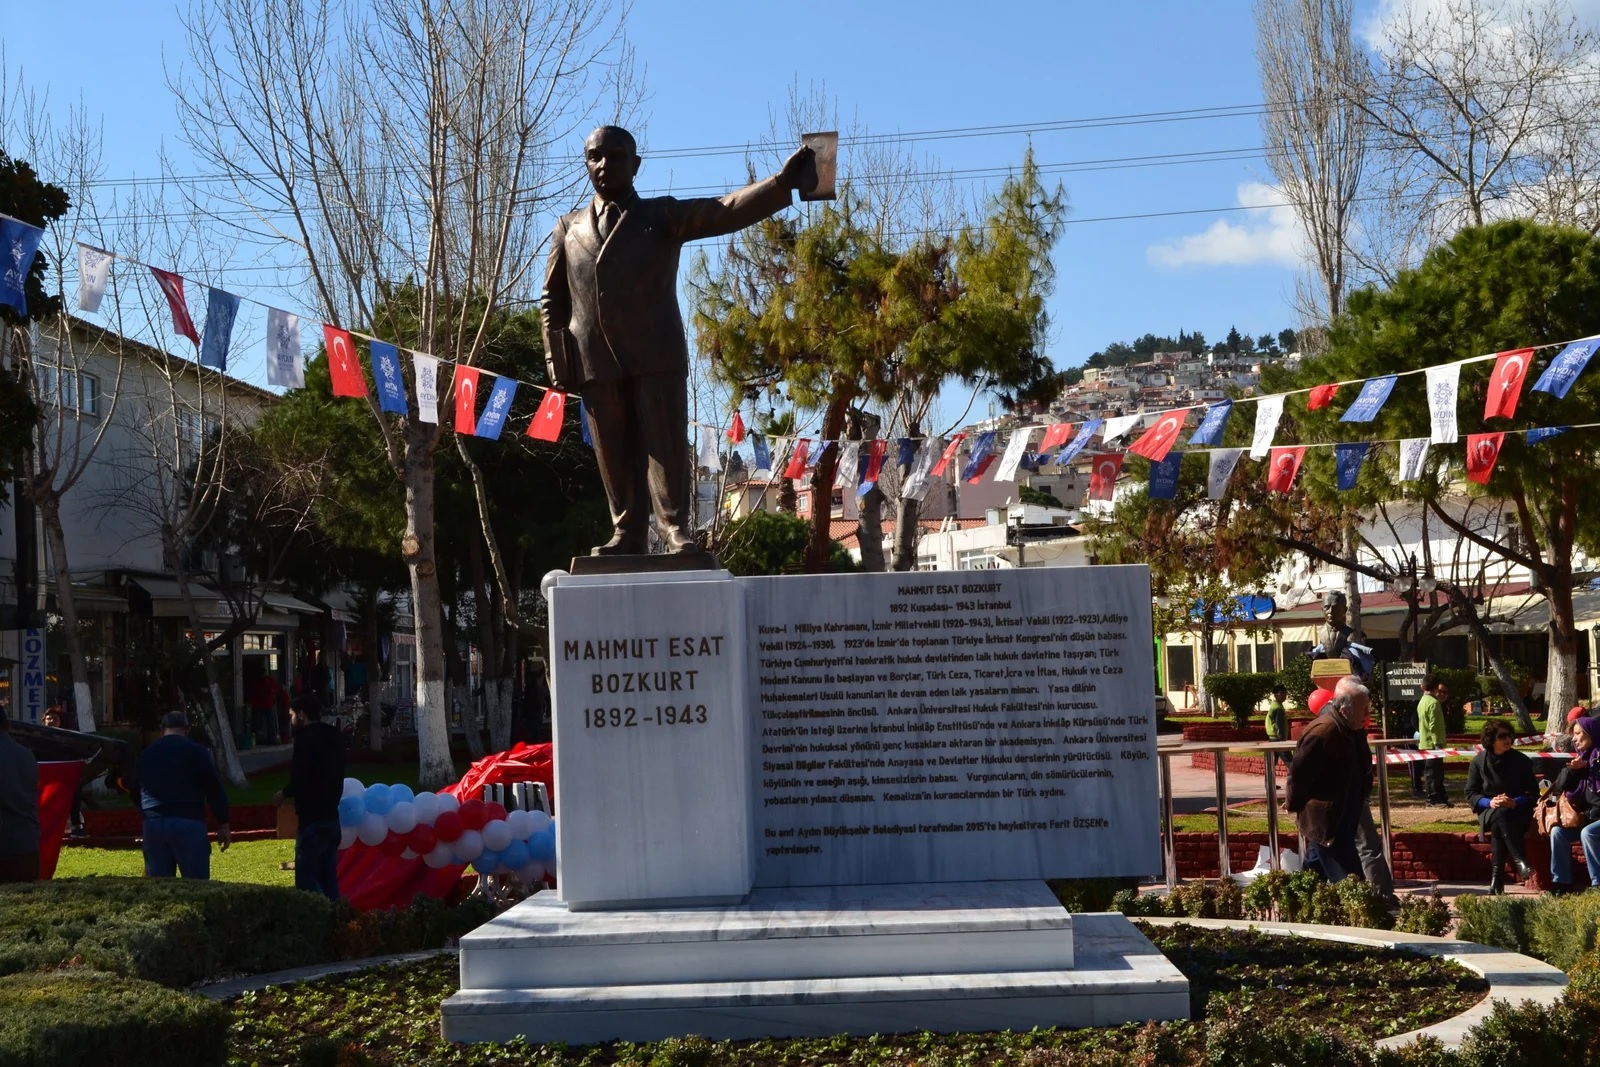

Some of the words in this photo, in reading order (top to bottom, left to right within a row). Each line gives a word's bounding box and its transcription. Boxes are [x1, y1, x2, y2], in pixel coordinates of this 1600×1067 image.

[898, 585, 934, 595] MAHMUT
[936, 584, 959, 594] ESAT
[962, 583, 1002, 593] BOZKURT
[889, 603, 908, 613] 1892
[955, 601, 975, 611] 1943
[977, 598, 1012, 610] İstanbul
[794, 623, 822, 635] Milliye
[823, 621, 870, 634] Kahramanı,
[871, 619, 893, 630] İzmir
[894, 619, 941, 630] Milletvekili
[942, 618, 994, 630] (1920-1943),
[995, 615, 1024, 627] İktisat
[1025, 616, 1050, 626] Vekili
[563, 639, 659, 661] MAHMUT
[669, 635, 724, 658] ESAT
[759, 641, 784, 651] Vekili
[785, 639, 836, 652] (1924-1930).
[843, 638, 875, 648] 1923'de
[877, 635, 910, 647] İzmir'de
[912, 636, 949, 649] toplanan
[951, 635, 984, 648] Türkiye
[985, 632, 1014, 644] İktisat
[1016, 632, 1068, 646] Kongresi'nin
[1069, 632, 1096, 643] düşün
[1097, 631, 1127, 640] babası.
[759, 658, 792, 671] Türkiye
[794, 656, 853, 670] Cumhuriyeti'ni
[855, 655, 895, 665] teokratik
[897, 654, 923, 664] hukuk
[924, 652, 974, 663] devletinden
[976, 652, 992, 661] laik
[993, 651, 1019, 661] hukuk
[1063, 648, 1097, 661] taşıyan;
[1099, 648, 1120, 657] Türk
[24, 627, 43, 724] KOZMET
[591, 670, 699, 694] BOZKURT
[760, 675, 789, 685] Medeni
[791, 674, 822, 684] Kanunu
[837, 672, 875, 685] başlayan
[889, 671, 924, 683] Borçlar,
[926, 670, 946, 680] Türk
[948, 669, 971, 681] Ceza,
[1024, 669, 1035, 677] ve
[1037, 665, 1060, 678] İflas,
[1061, 666, 1088, 676] Hukuk
[1090, 667, 1100, 675] ve
[1102, 665, 1123, 674] Ceza
[760, 691, 818, 702] Muhakemeleri
[819, 690, 844, 700] Usulü
[846, 689, 886, 699] kanunları
[900, 688, 927, 698] devam
[929, 687, 950, 697] eden
[951, 687, 967, 696] laik
[969, 685, 1009, 698] yasaların
[1010, 684, 1040, 694] mimarı.
[1047, 684, 1070, 693] Yasa
[1071, 683, 1096, 693] dilinin
[584, 704, 708, 729] 1892-1943
[847, 707, 879, 717] öncüsü.
[887, 705, 918, 715] Ankara
[919, 702, 971, 714] Üniversitesi
[972, 703, 999, 713] Hukuk
[1001, 701, 1055, 712] Fakültesi'nin
[1057, 700, 1098, 710] kurucusu.
[762, 726, 809, 736] Atatürk'ün
[810, 725, 835, 737] isteği
[837, 724, 869, 734] üzerine
[870, 721, 905, 733] İstanbul
[937, 720, 995, 731] Enstitüsü'nde
[1010, 719, 1041, 729] Ankara
[1073, 716, 1126, 727] Kürsüsü'nde
[1128, 715, 1148, 725] Türk
[762, 743, 808, 753] Devrimi'nin
[809, 742, 848, 752] hukuksal
[850, 741, 881, 754] yönünü
[882, 742, 902, 753] genç
[904, 739, 947, 751] kuşaklara
[949, 738, 983, 748] aktaran
[984, 737, 997, 747] bir
[999, 736, 1055, 749] akademisyen.
[1062, 734, 1094, 744] Ankara
[1095, 731, 1147, 743] Üniversitesi
[762, 760, 794, 773] Siyasal
[828, 758, 885, 768] Fakültesi'nde
[887, 757, 924, 769] Anayasa
[939, 755, 979, 765] Devletler
[981, 754, 1012, 764] Hukuku
[1014, 752, 1061, 763] derslerinin
[1062, 751, 1113, 764] yürütücüsü.
[1120, 750, 1149, 762] Köyün,
[763, 777, 802, 790] köylünün
[816, 776, 845, 789] emeğin
[847, 775, 870, 788] aşığı,
[871, 774, 927, 784] kimsesizlerin
[929, 773, 959, 783] babası.
[966, 771, 1029, 784] Vurguncuların,
[1030, 770, 1043, 780] din
[1045, 768, 1114, 781] sömürücülerinin,
[764, 794, 809, 807] yobazların
[810, 793, 838, 806] yılmaz
[839, 792, 875, 804] düşmanı.
[1002, 788, 1014, 797] bir
[1017, 787, 1037, 797] Türk
[1039, 786, 1066, 799] aydını.
[764, 828, 777, 837] Bu
[778, 827, 795, 837] anıt
[797, 826, 822, 839] Aydın
[872, 823, 916, 837] Belediyesi
[918, 822, 964, 832] tarafından
[1049, 819, 1071, 828] Ferit
[1073, 816, 1109, 828] ÖZŞEN'e
